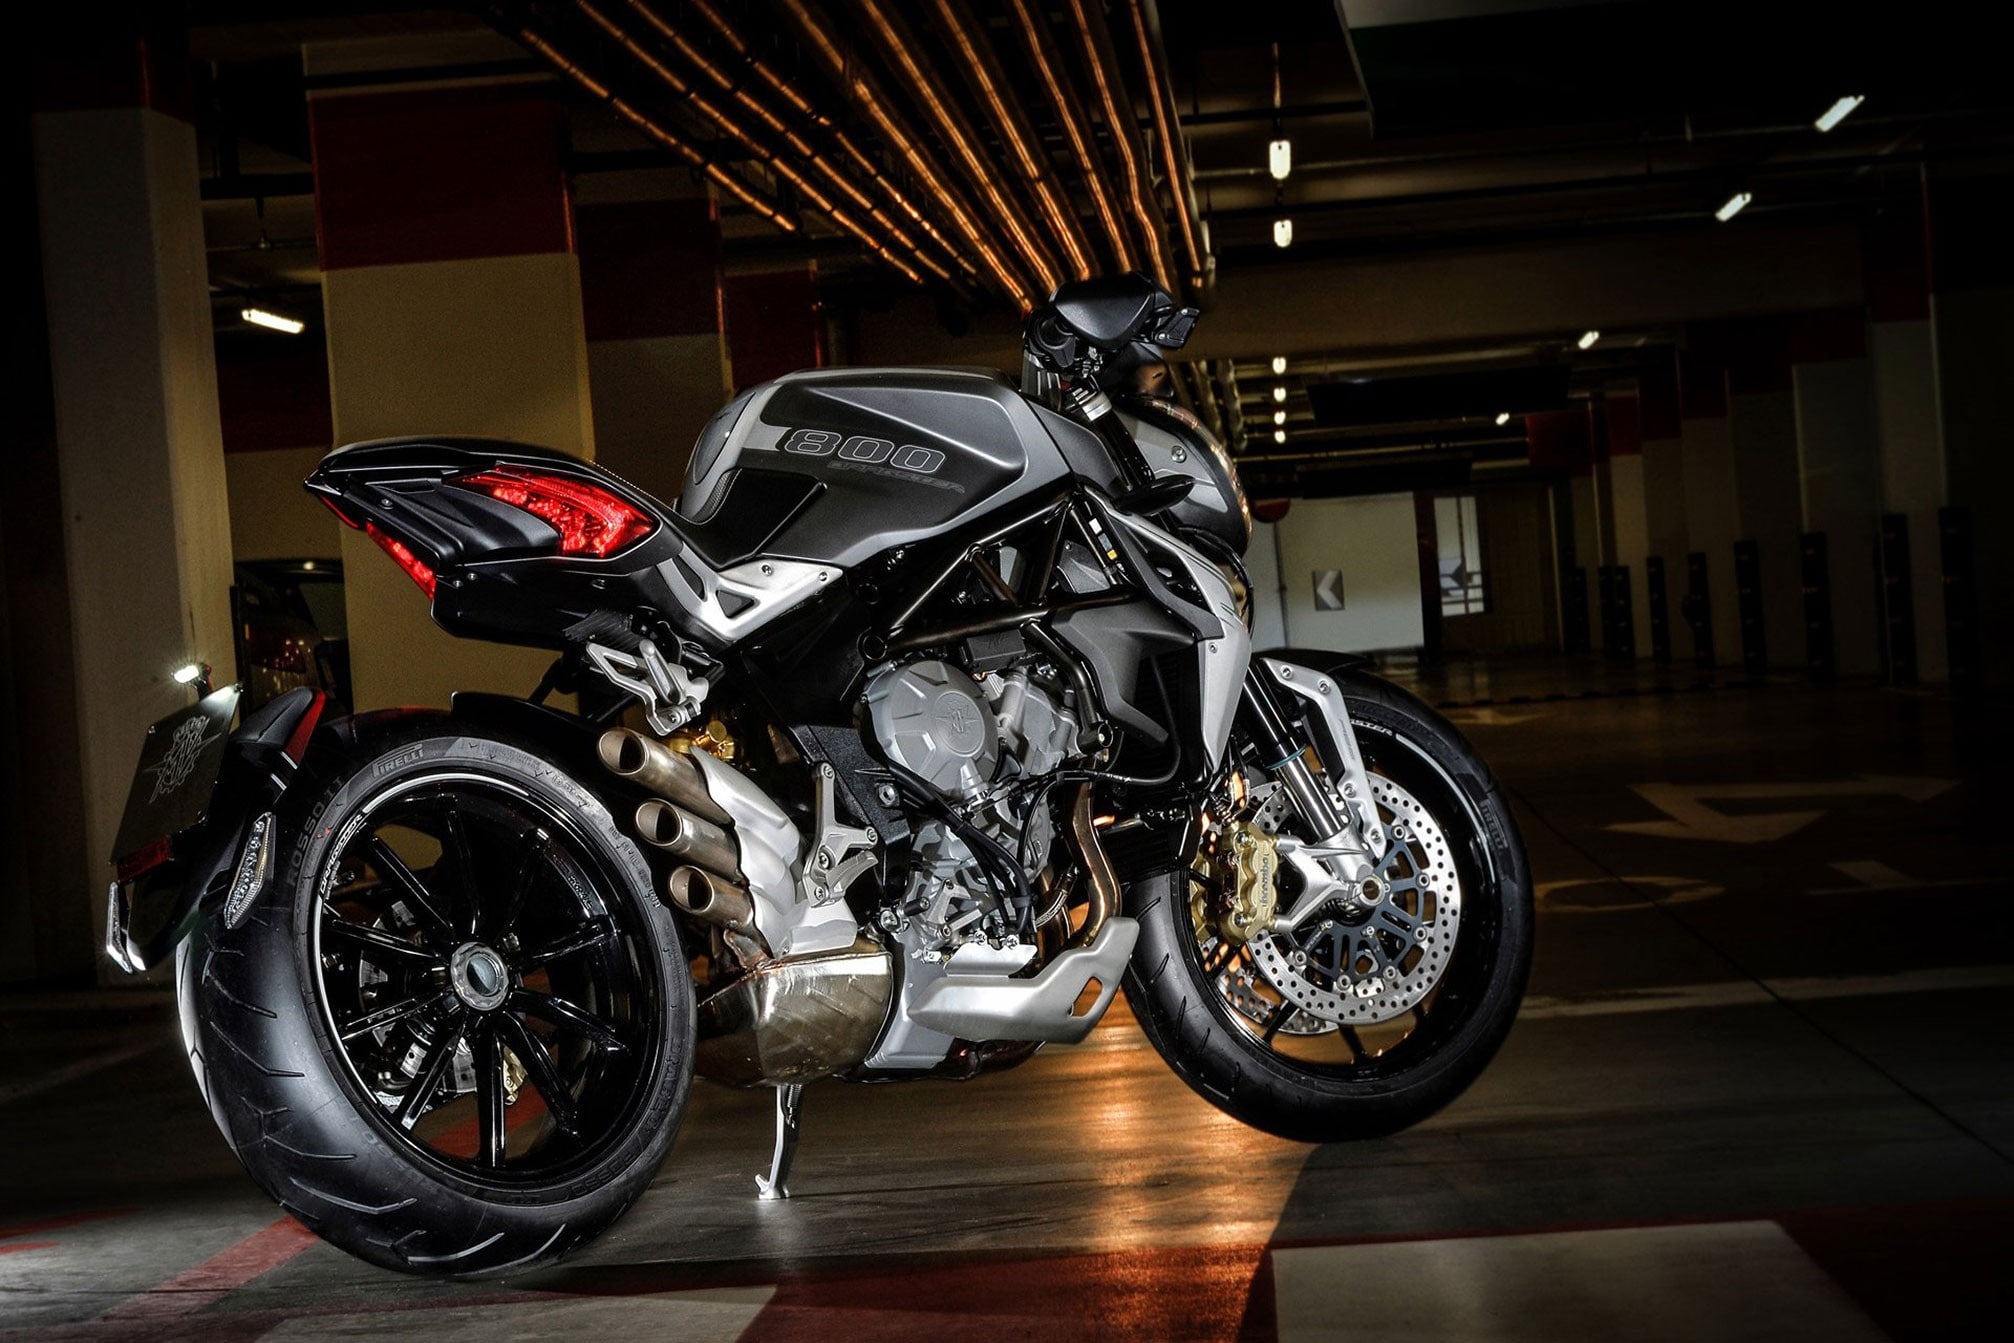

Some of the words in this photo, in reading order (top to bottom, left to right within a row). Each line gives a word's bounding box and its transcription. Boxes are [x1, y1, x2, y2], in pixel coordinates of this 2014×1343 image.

[784, 429, 946, 474] 800
[371, 743, 424, 778] PIRELLI
[1480, 799, 1509, 850] PIRELLI
[1258, 855, 1269, 905] brembo
